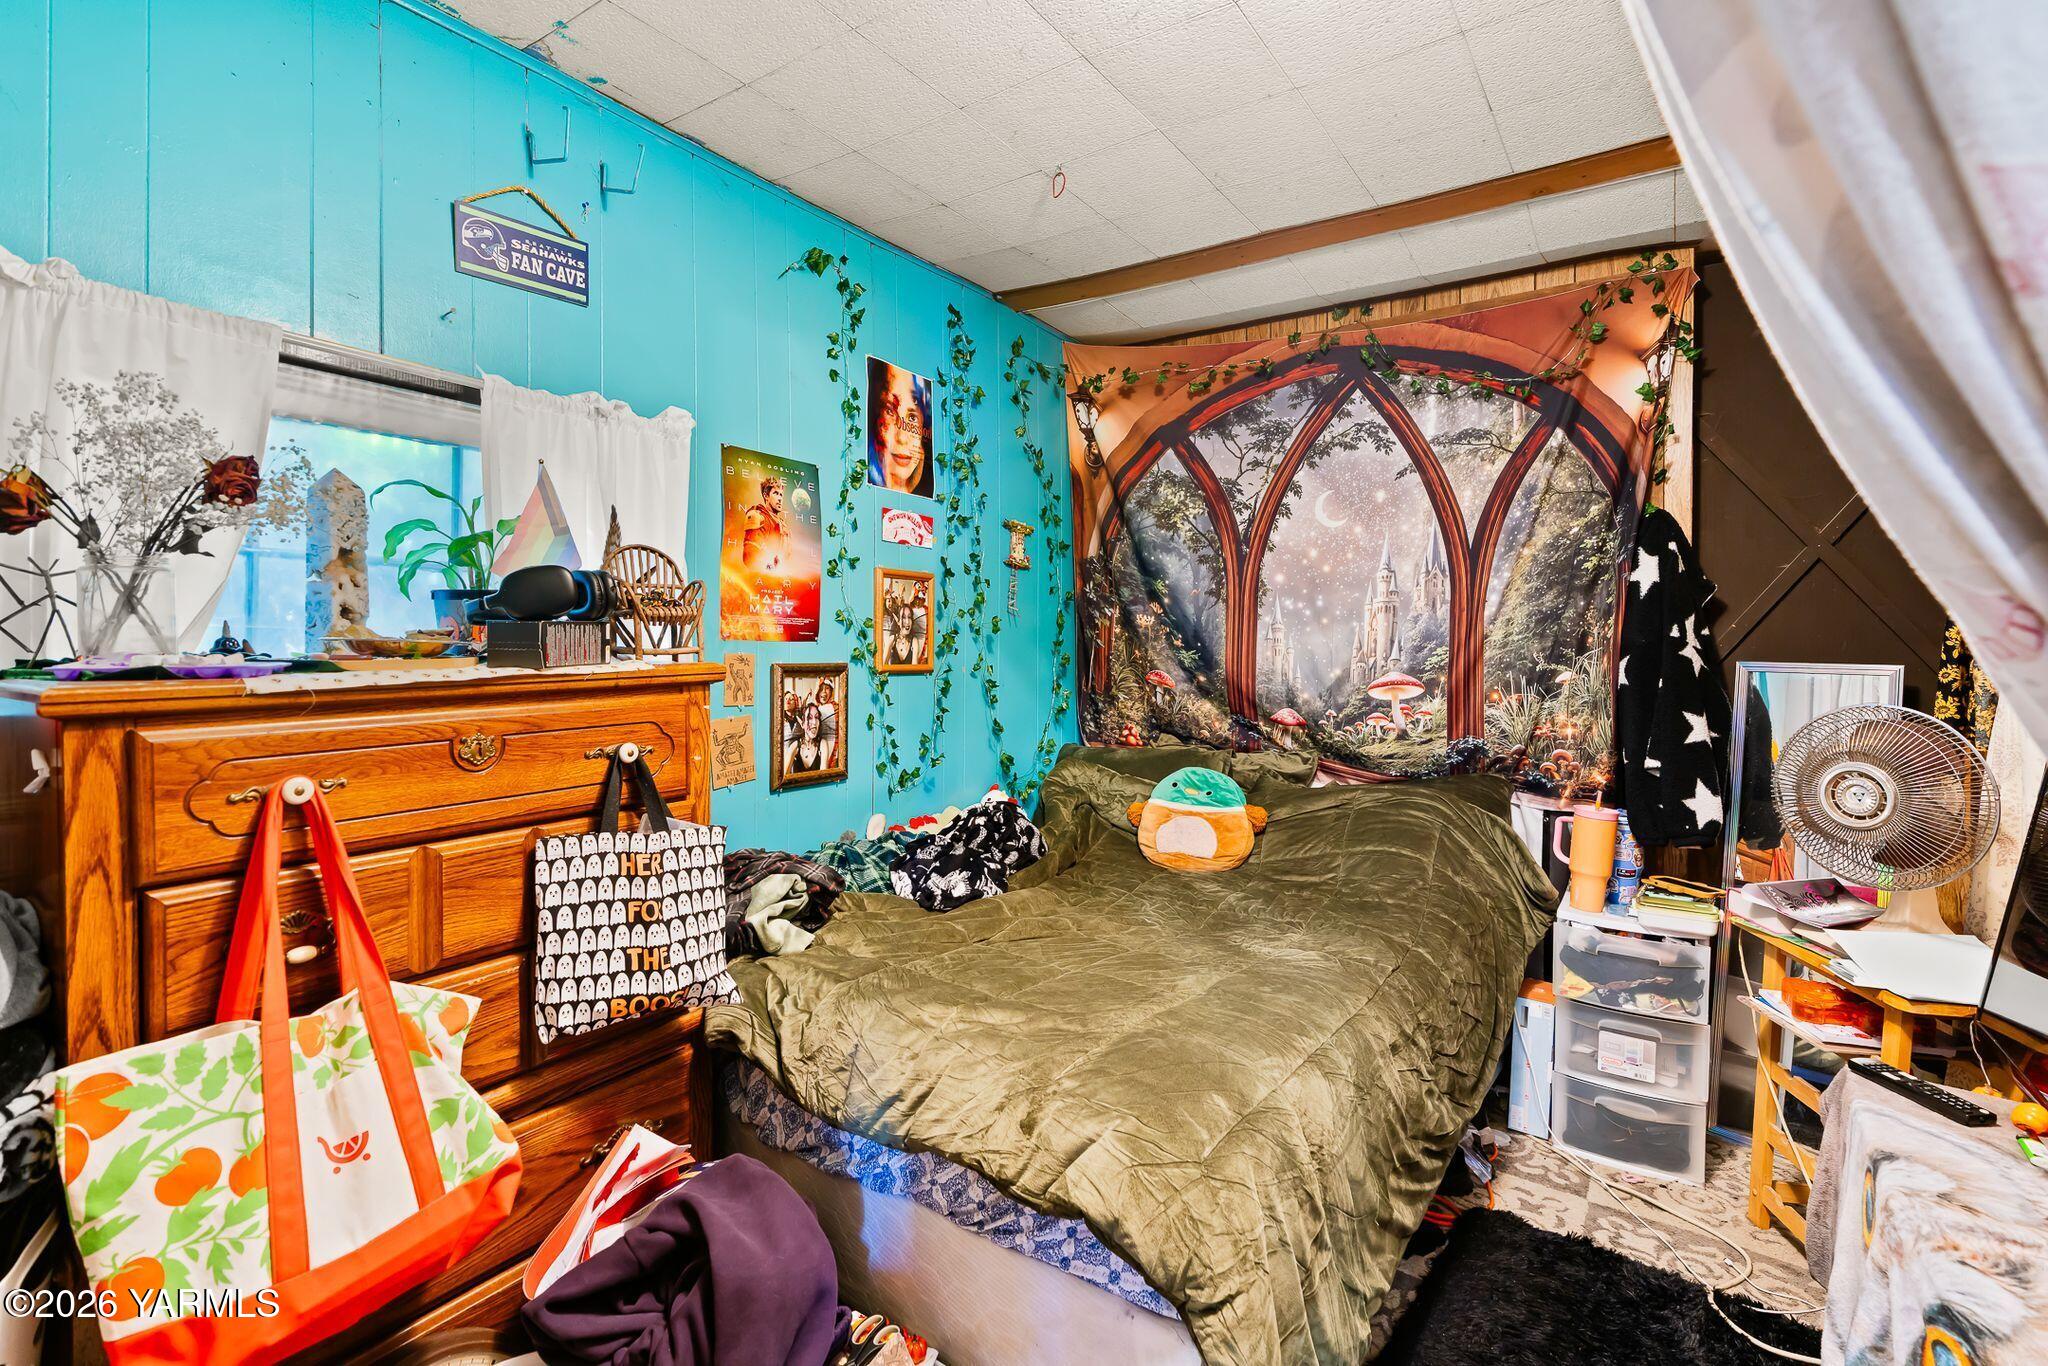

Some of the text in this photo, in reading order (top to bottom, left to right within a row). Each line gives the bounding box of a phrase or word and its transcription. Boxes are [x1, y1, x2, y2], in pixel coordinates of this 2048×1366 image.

[511, 239, 585, 269] SEAHAWKS
[525, 239, 573, 257] SEATTLE
[511, 251, 586, 289] FAN CAVE
[749, 594, 794, 606] HAIL
[749, 604, 794, 616] MARY
[626, 947, 671, 971] THE
